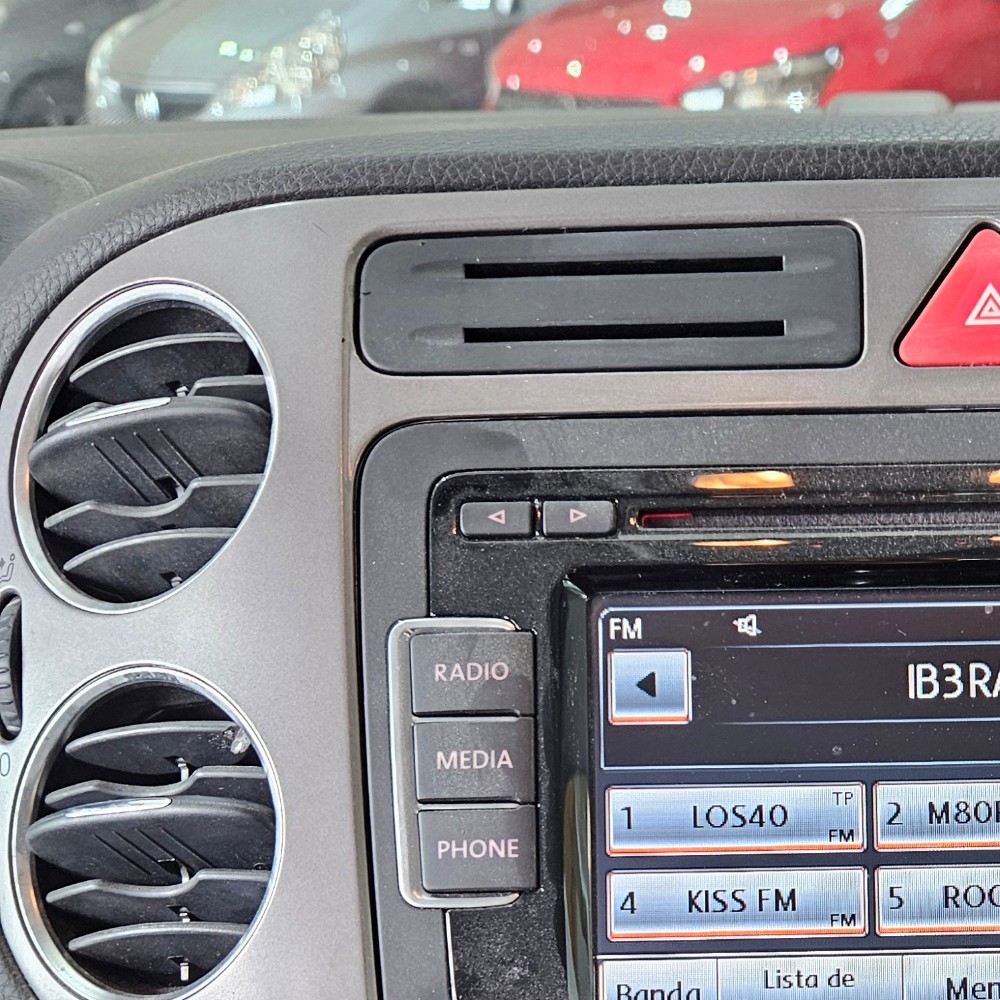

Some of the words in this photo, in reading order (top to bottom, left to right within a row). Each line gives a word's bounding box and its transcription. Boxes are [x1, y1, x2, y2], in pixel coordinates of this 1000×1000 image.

[609, 617, 642, 640] FM
[434, 661, 510, 682] RADIO
[436, 749, 514, 770] MEDIA
[832, 791, 854, 806] TP
[620, 806, 633, 830] 1
[692, 803, 789, 829] LOS40
[886, 802, 904, 826] 2
[828, 828, 855, 843] FM
[437, 839, 519, 860] PHONE
[619, 890, 637, 914] 4
[688, 889, 747, 914] KISS
[757, 887, 798, 912] FM
[889, 885, 905, 910] 5
[830, 914, 856, 928] FM
[763, 969, 818, 990] Lista
[827, 968, 855, 989] de
